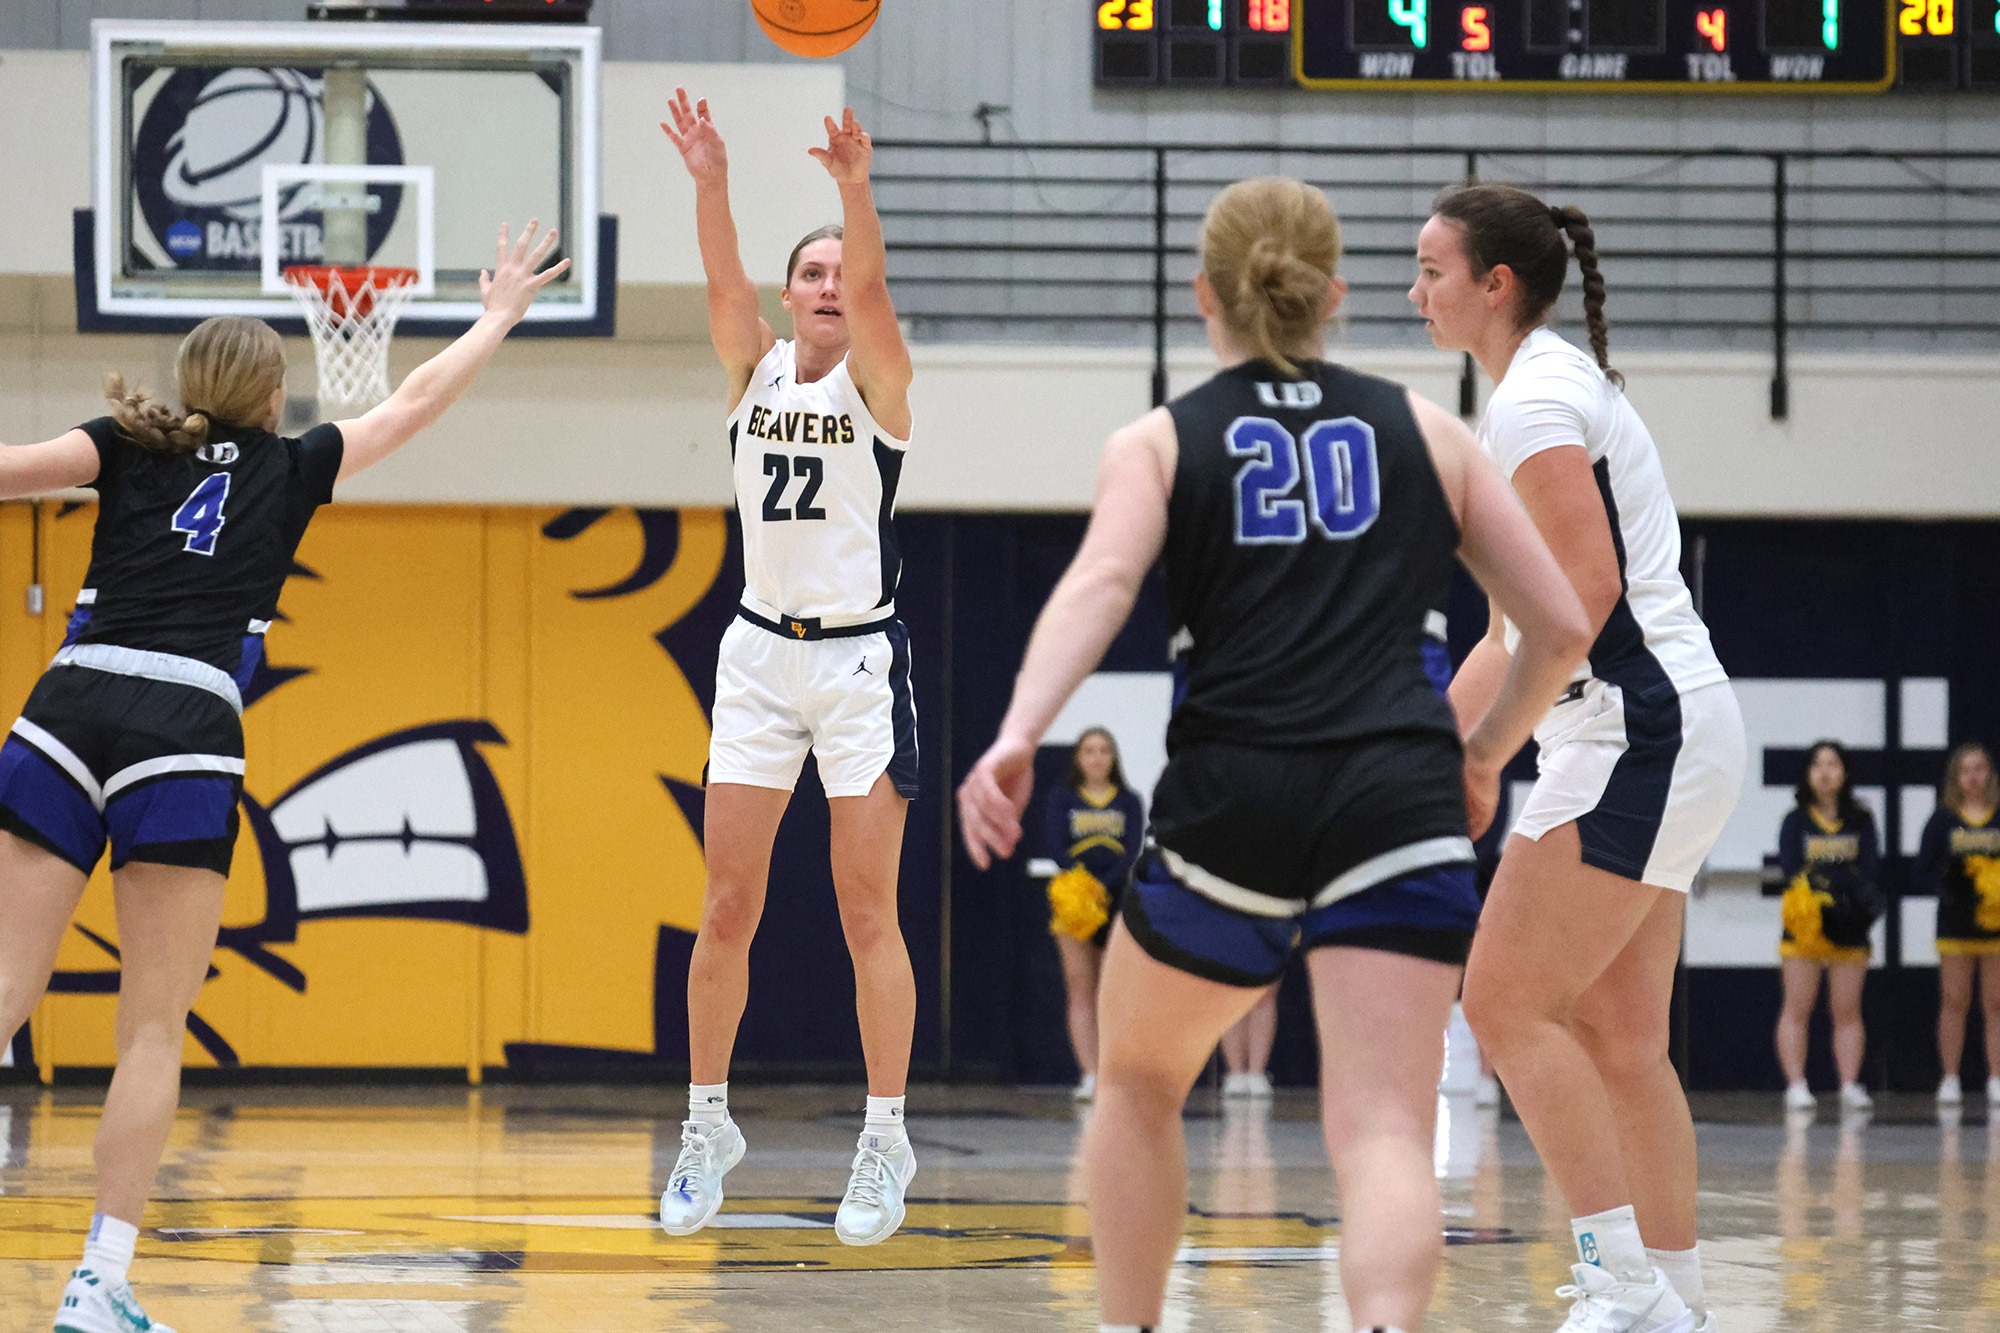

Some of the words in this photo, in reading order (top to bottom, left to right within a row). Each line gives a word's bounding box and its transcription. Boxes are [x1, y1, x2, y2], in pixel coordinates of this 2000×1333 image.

[1388, 0, 1427, 48] 4
[1461, 6, 1490, 50] 5
[1697, 8, 1725, 51] 4
[1900, 0, 1954, 35] 20
[747, 404, 855, 444] BEAVERS
[762, 452, 827, 521] 22
[1224, 415, 1381, 545] 20
[171, 471, 231, 556] 4
